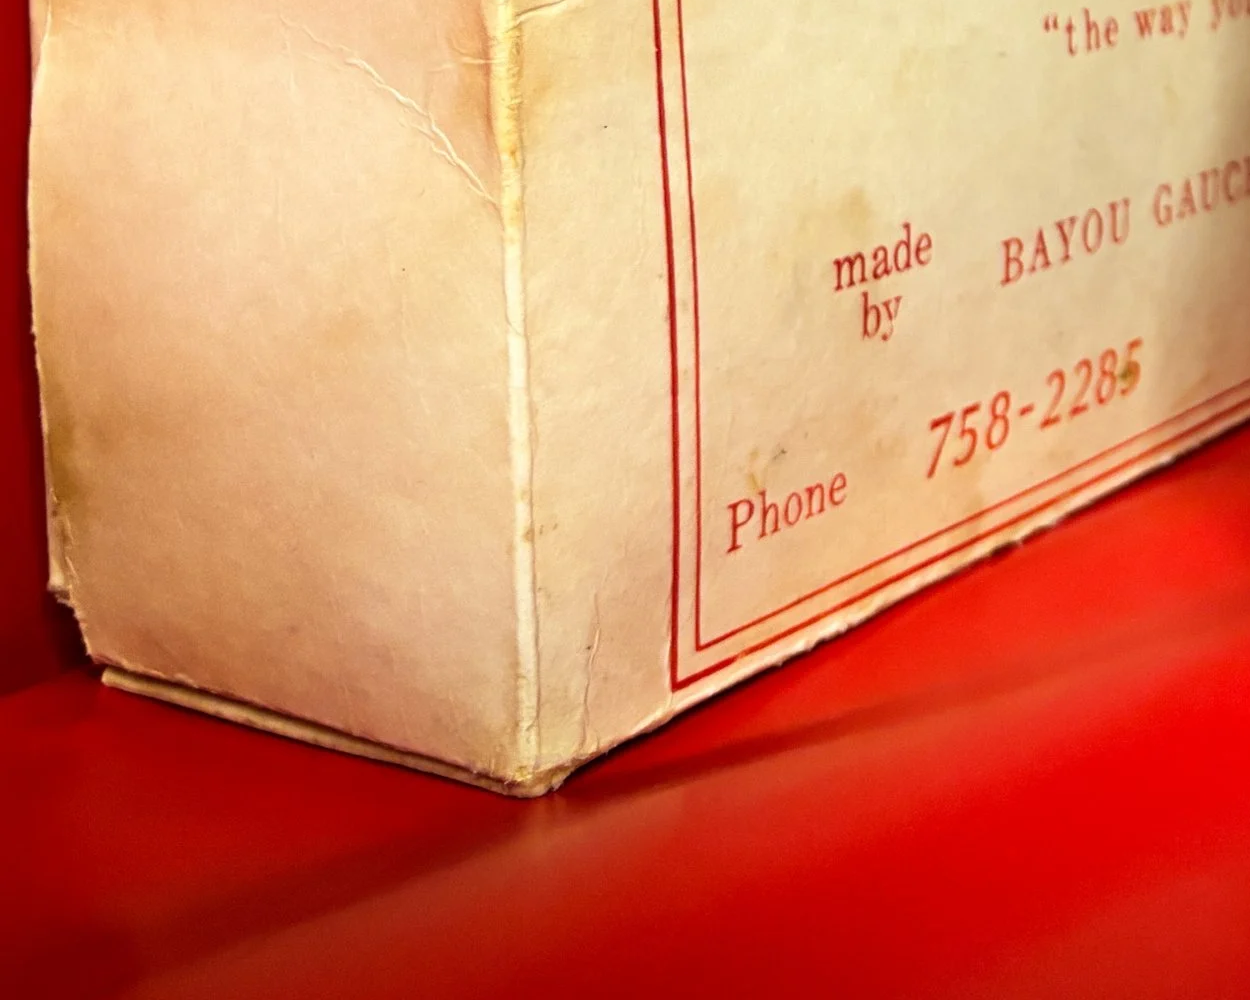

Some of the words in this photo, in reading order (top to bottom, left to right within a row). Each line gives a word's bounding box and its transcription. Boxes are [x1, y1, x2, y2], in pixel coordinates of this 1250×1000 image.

[833, 222, 933, 292] made
[1000, 198, 1132, 287] BAYOU
[860, 291, 903, 341] by
[727, 471, 849, 555] Phone
